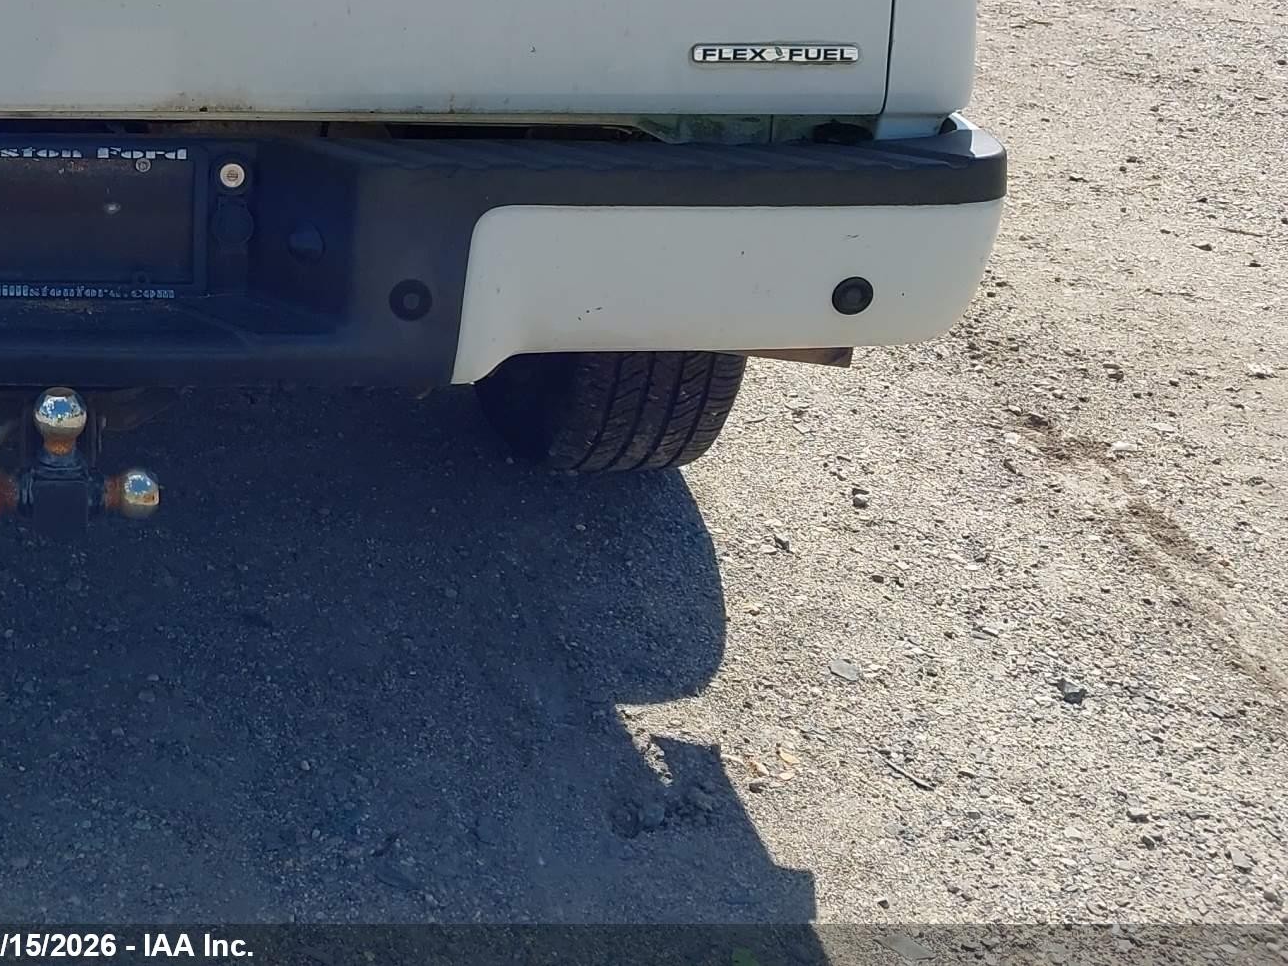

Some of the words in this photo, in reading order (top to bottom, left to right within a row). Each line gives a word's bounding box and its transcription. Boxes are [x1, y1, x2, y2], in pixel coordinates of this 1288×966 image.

[702, 48, 767, 61] FLEX
[788, 48, 854, 61] FUEL
[97, 146, 188, 160] Ford
